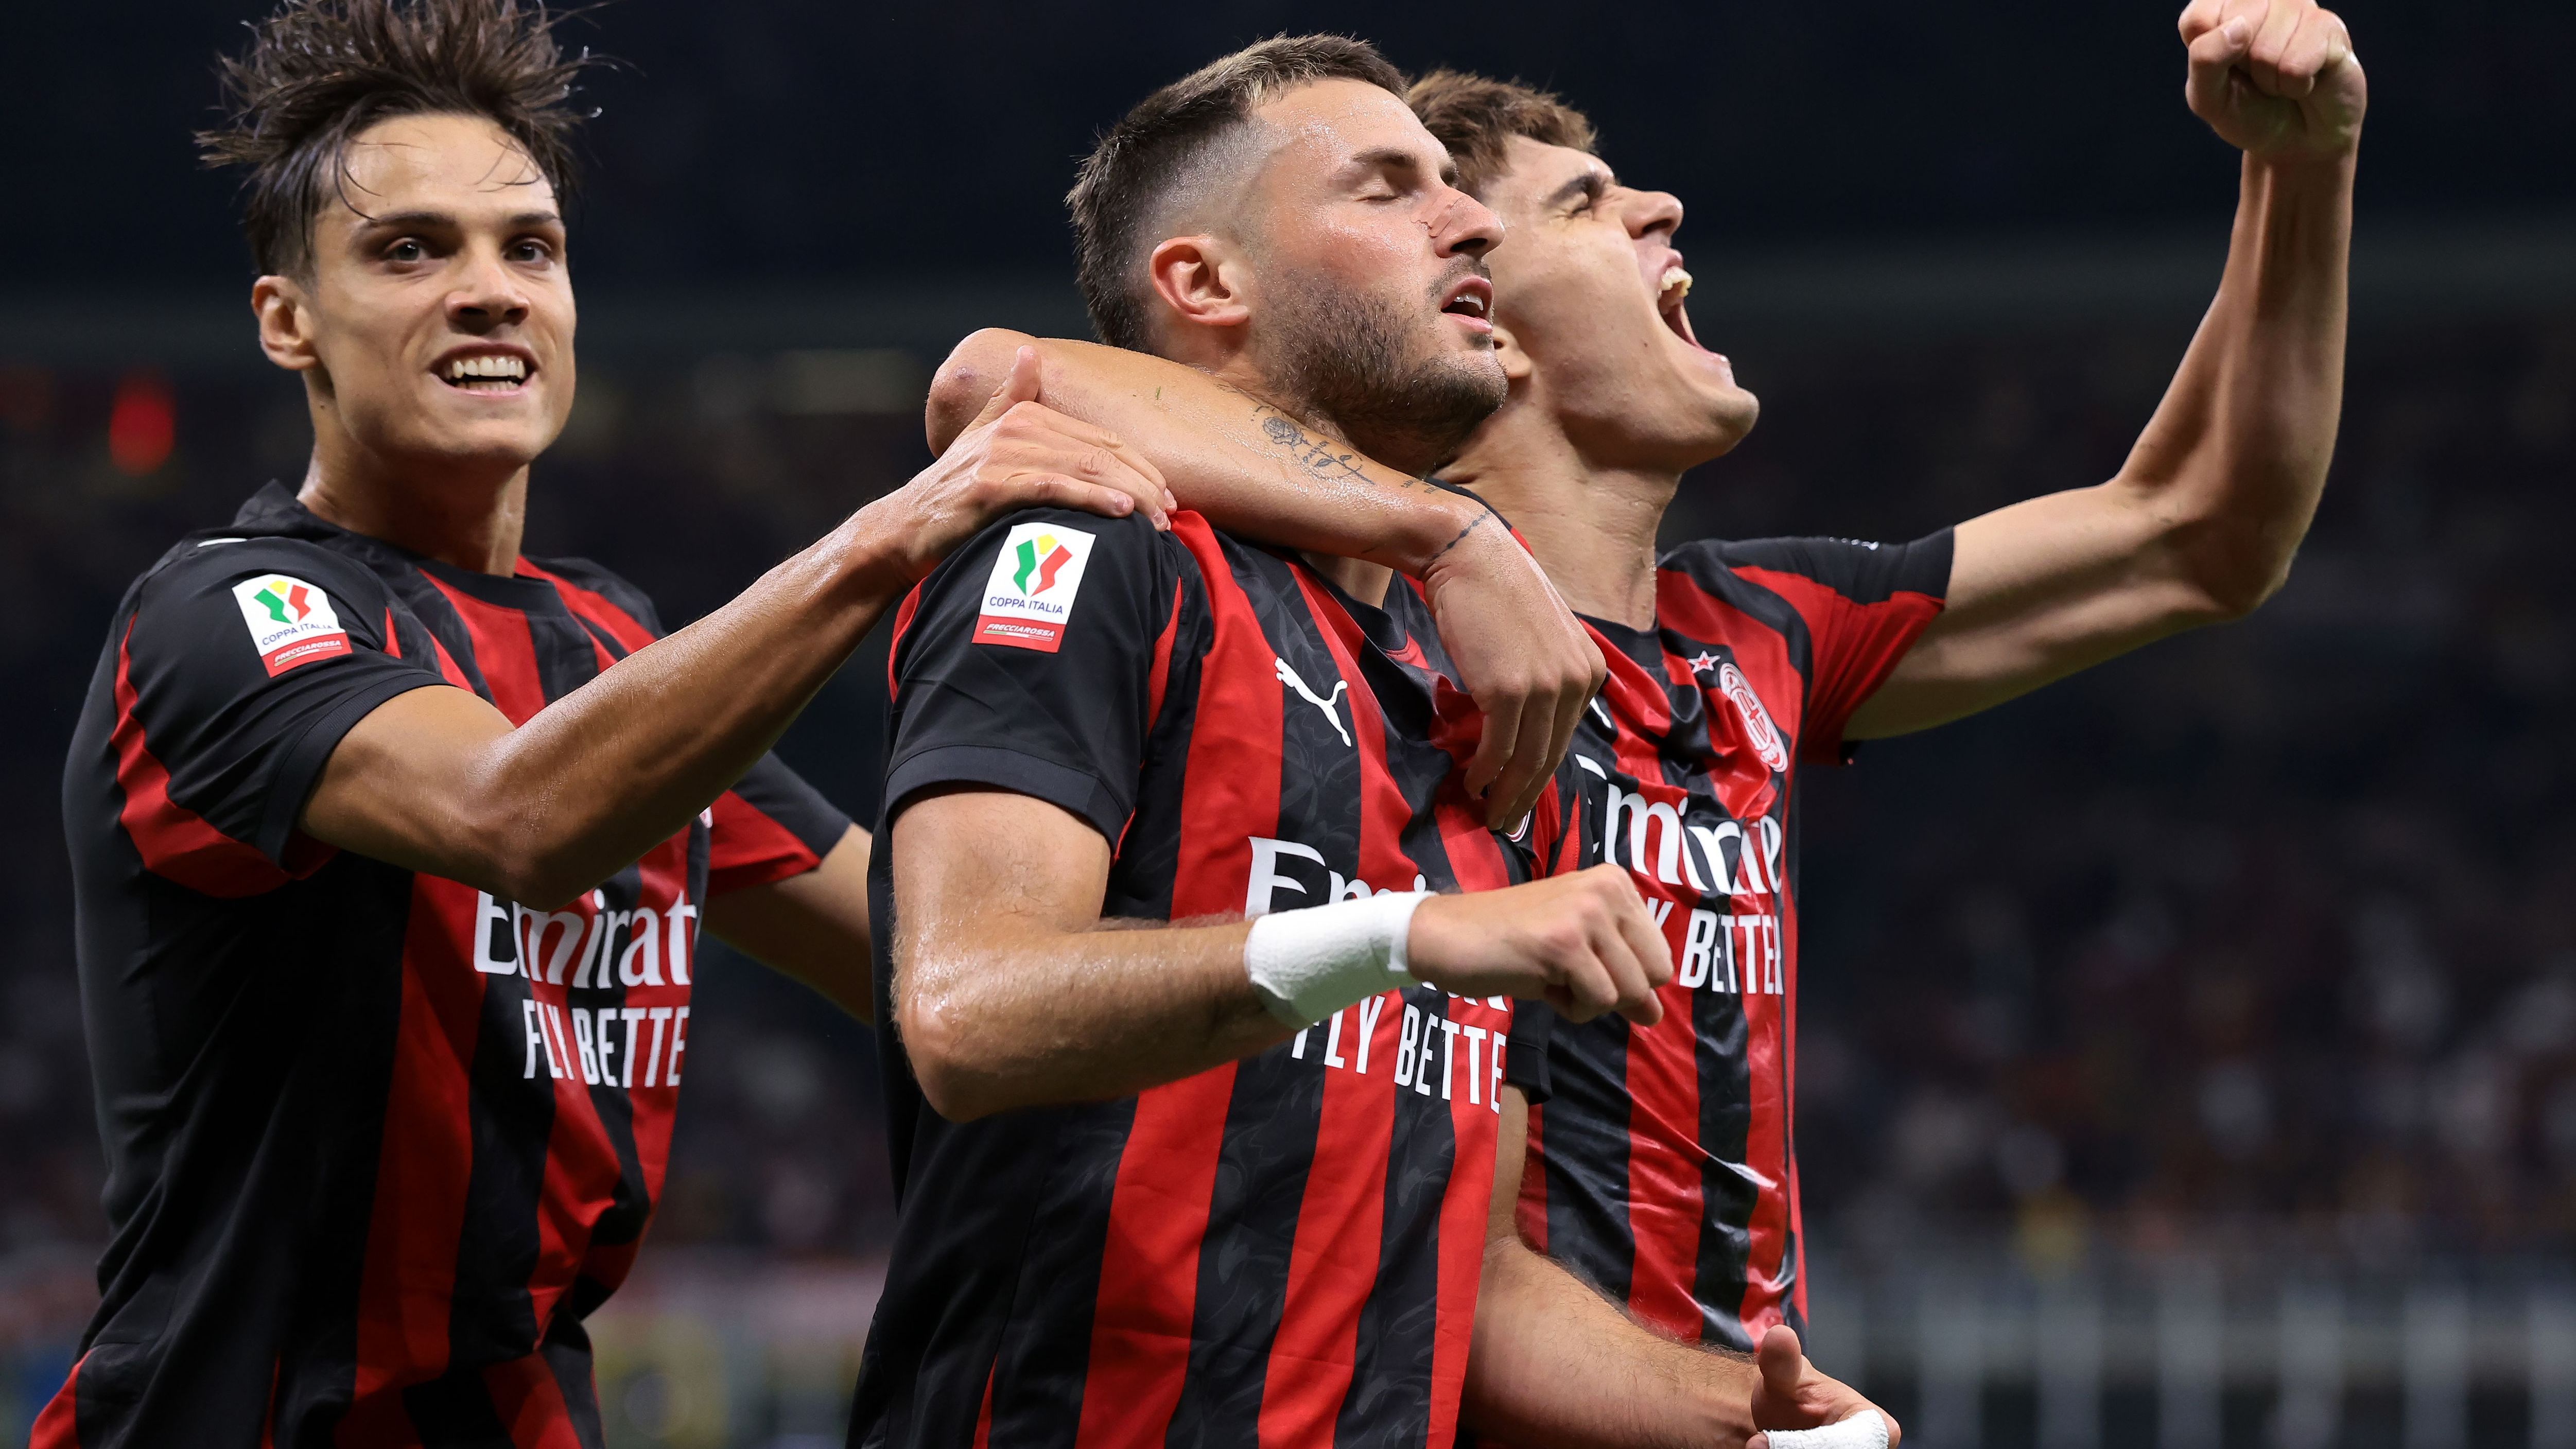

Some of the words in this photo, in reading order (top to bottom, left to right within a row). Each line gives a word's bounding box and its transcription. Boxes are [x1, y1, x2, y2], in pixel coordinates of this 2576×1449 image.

[989, 597, 1025, 608] COPPA
[1029, 601, 1063, 615] ITALIA
[262, 627, 299, 645] COPPA
[987, 623, 1056, 638] FRECCIAROSSA
[274, 640, 341, 662] FRECCIAROSSA
[522, 999, 575, 1080] FLY
